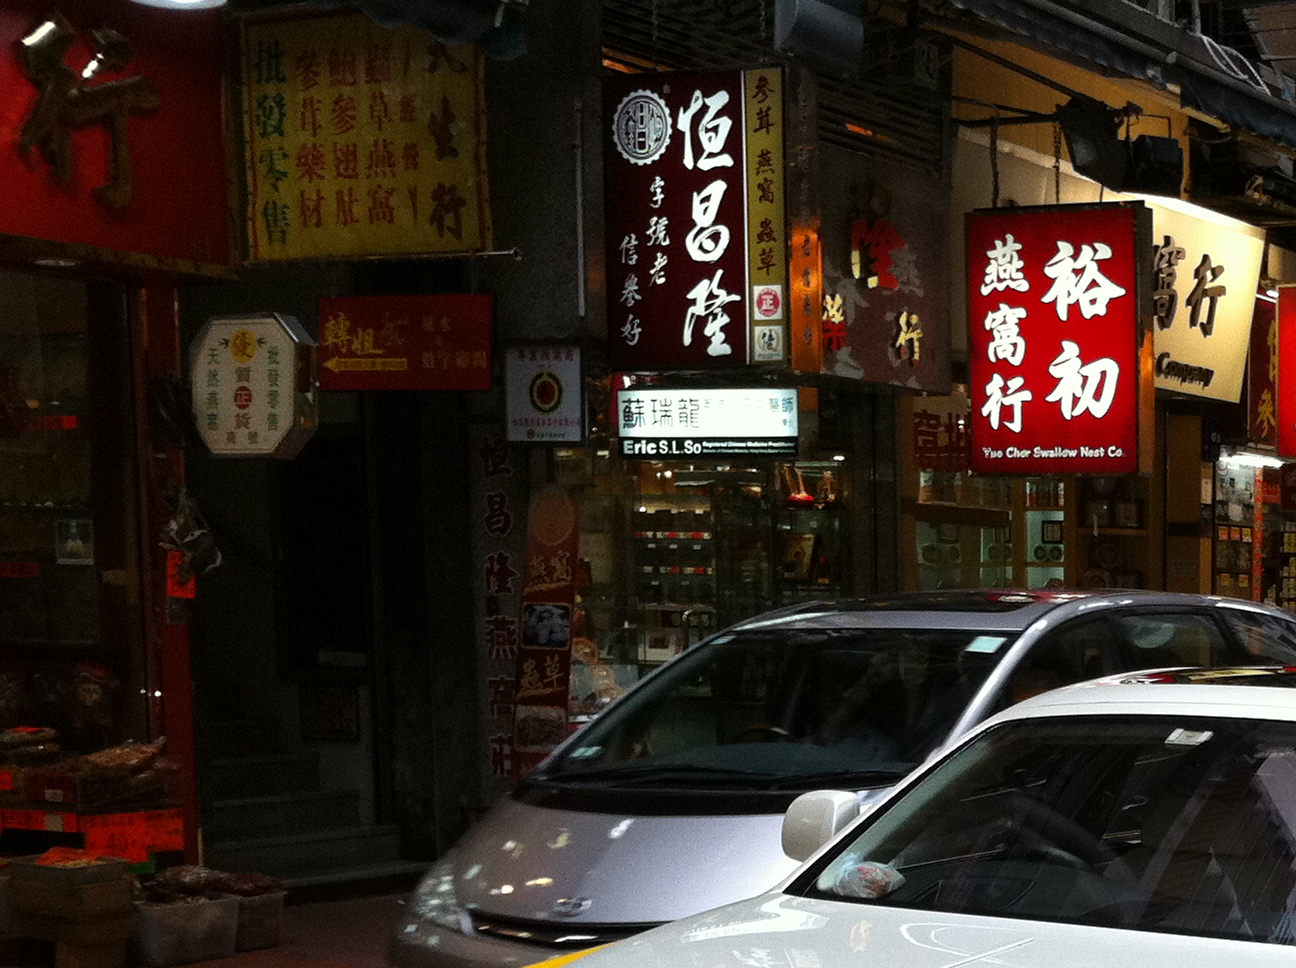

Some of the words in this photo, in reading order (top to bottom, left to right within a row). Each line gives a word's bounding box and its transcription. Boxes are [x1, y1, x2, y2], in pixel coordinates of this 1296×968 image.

[677, 90, 741, 356] 恒昌隆
[980, 233, 1032, 434] 燕窩行
[1040, 240, 1126, 420] 裕初
[1154, 352, 1214, 390] Company
[622, 398, 700, 429] 蘇瑞龍
[623, 440, 657, 454] Eric
[982, 446, 1003, 459] Yue
[1006, 446, 1031, 458] Chor
[1033, 446, 1077, 458] Swallow
[1080, 446, 1104, 458] Nest
